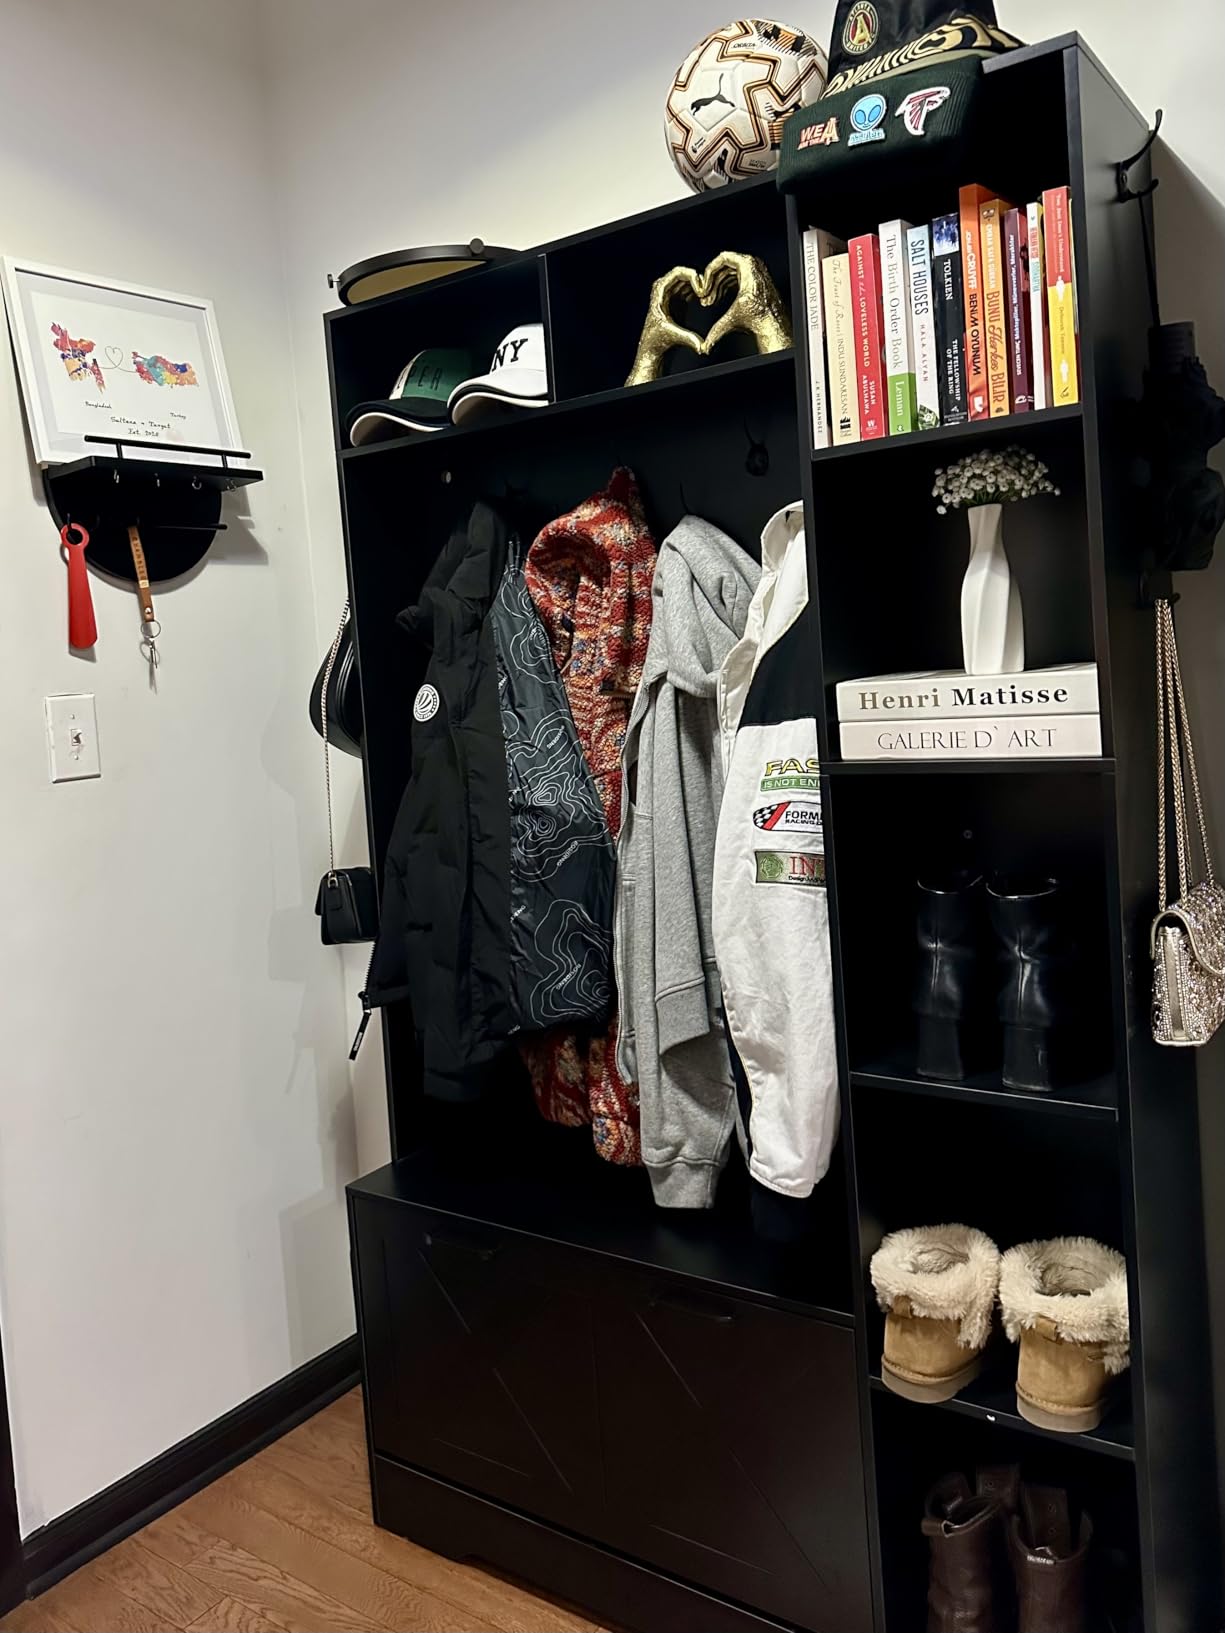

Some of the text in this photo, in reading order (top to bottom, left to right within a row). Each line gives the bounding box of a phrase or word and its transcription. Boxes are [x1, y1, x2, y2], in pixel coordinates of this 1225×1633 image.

[856, 245, 865, 279] AGAINST
[911, 239, 929, 316] SALT HOUSES
[943, 259, 953, 300] TOLKIEN
[967, 253, 978, 290] CRUYFF
[806, 241, 819, 330] THE COLOR JADE
[886, 234, 904, 368] The Birth Order Book
[859, 298, 868, 337] LOVELESS
[986, 290, 1001, 323] BUNU
[491, 338, 529, 372] NY
[837, 338, 846, 359] INDU
[863, 338, 871, 367] WORLD
[946, 348, 952, 359] OF
[971, 329, 982, 376] OYUNUM
[988, 324, 1004, 371] Herkes
[921, 354, 929, 382] ALYAN
[953, 356, 961, 401] FELLOWSHIP
[839, 360, 848, 415] SUNDARESAN
[858, 684, 1069, 710] Henri Matisse
[877, 731, 968, 750] GALERIE
[1007, 728, 1057, 748] ART
[764, 778, 820, 788] IS NOT EN
